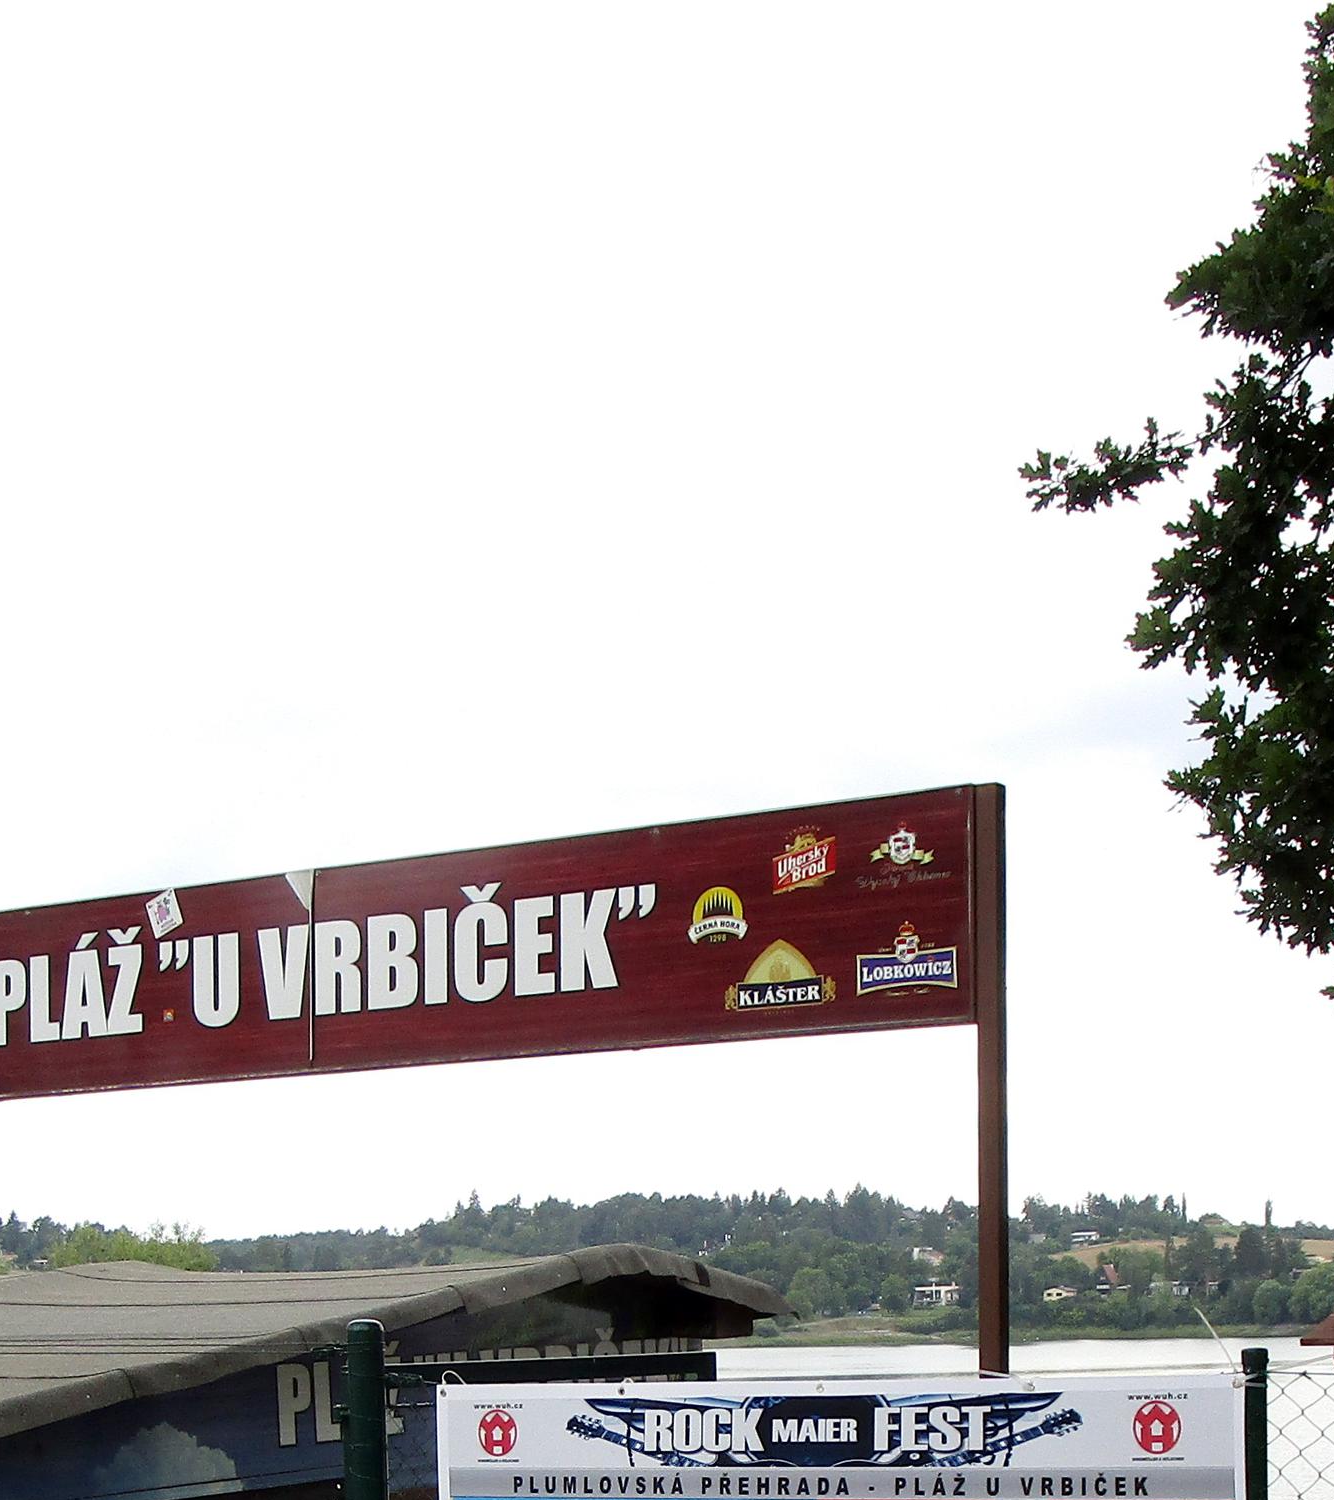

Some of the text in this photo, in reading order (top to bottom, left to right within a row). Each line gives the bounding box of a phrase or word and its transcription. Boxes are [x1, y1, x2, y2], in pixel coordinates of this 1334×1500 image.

[791, 857, 827, 884] Brod
[861, 958, 952, 983] LOBKOWICZ
[739, 983, 821, 1008] KLÁŠTER
[1127, 1393, 1188, 1401] www.wuh.cz
[643, 1405, 991, 1452] ROCK MAIER FEST
[513, 1472, 1150, 1498] PLUMLOVSKÁ PŘEHRADA PLÁŽ U VRBIČEK
